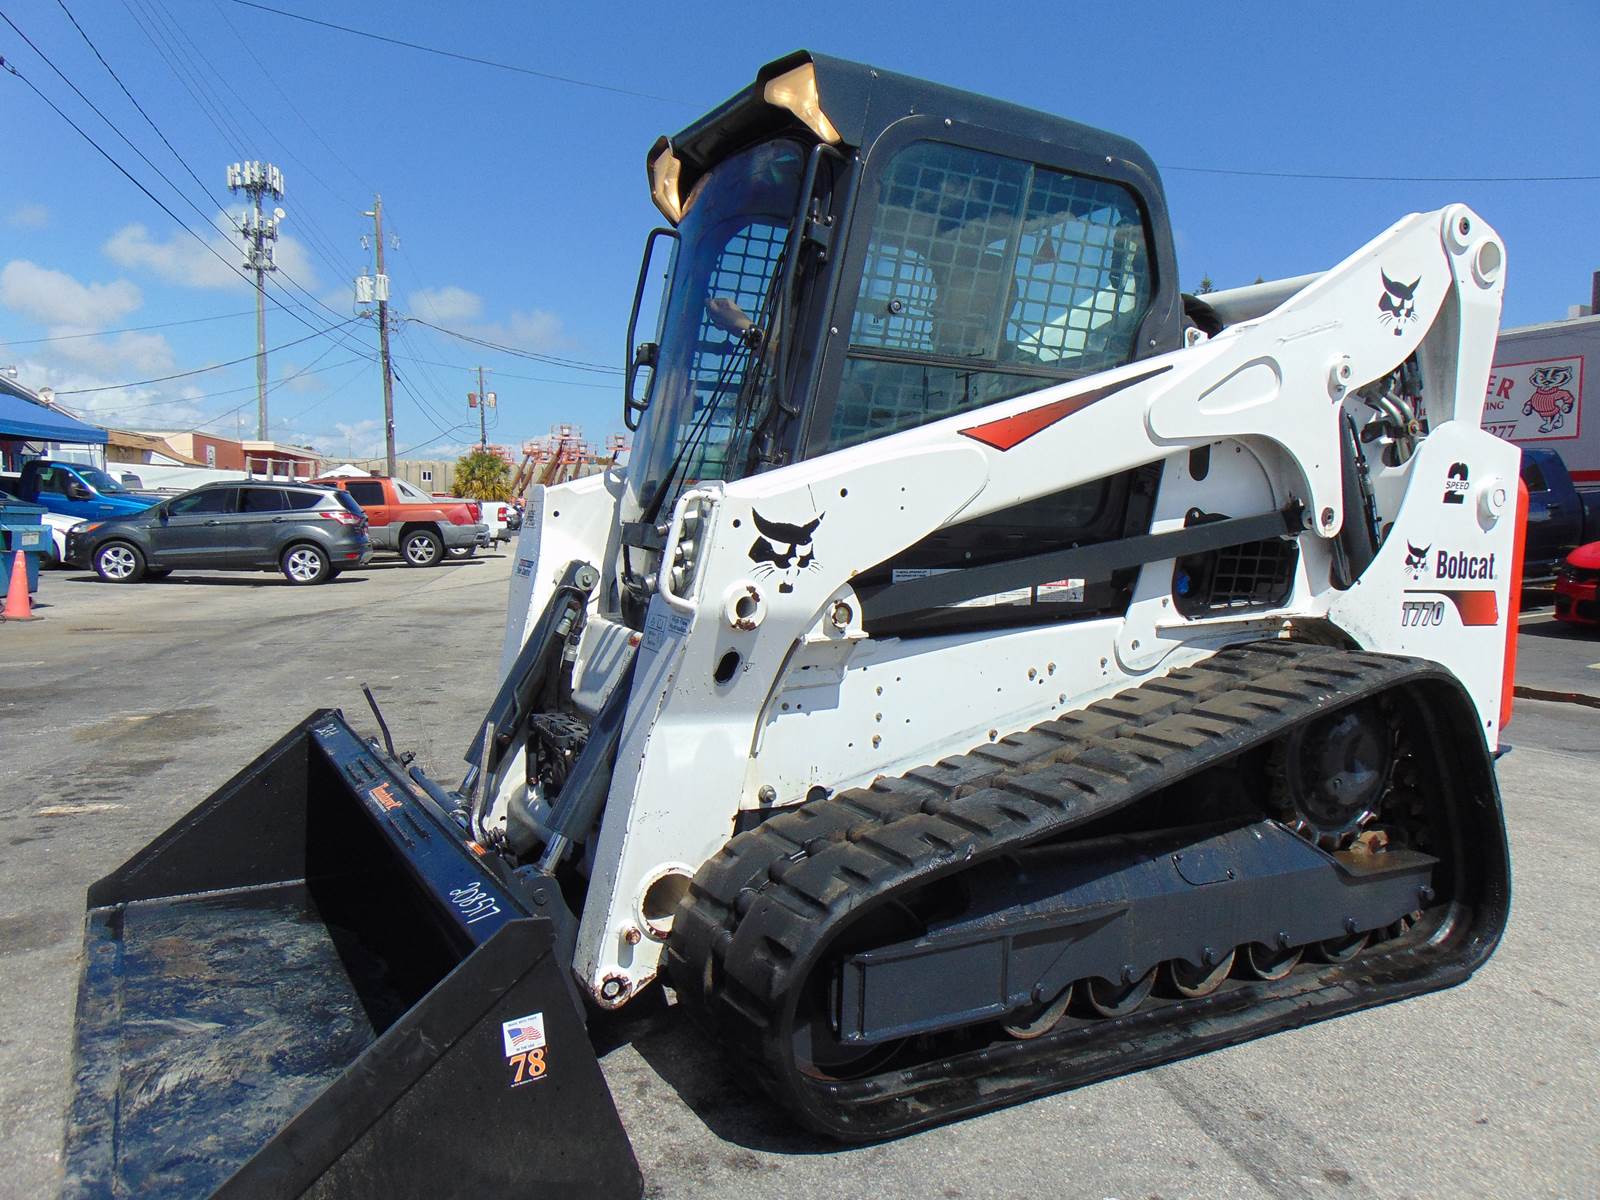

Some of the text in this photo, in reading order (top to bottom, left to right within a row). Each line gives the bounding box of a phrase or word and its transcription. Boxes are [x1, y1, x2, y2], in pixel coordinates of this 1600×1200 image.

[1480, 425, 1516, 438] 277
[1445, 481, 1470, 490] SPEED
[1436, 550, 1495, 580] Bobcat
[1402, 601, 1445, 627] T770
